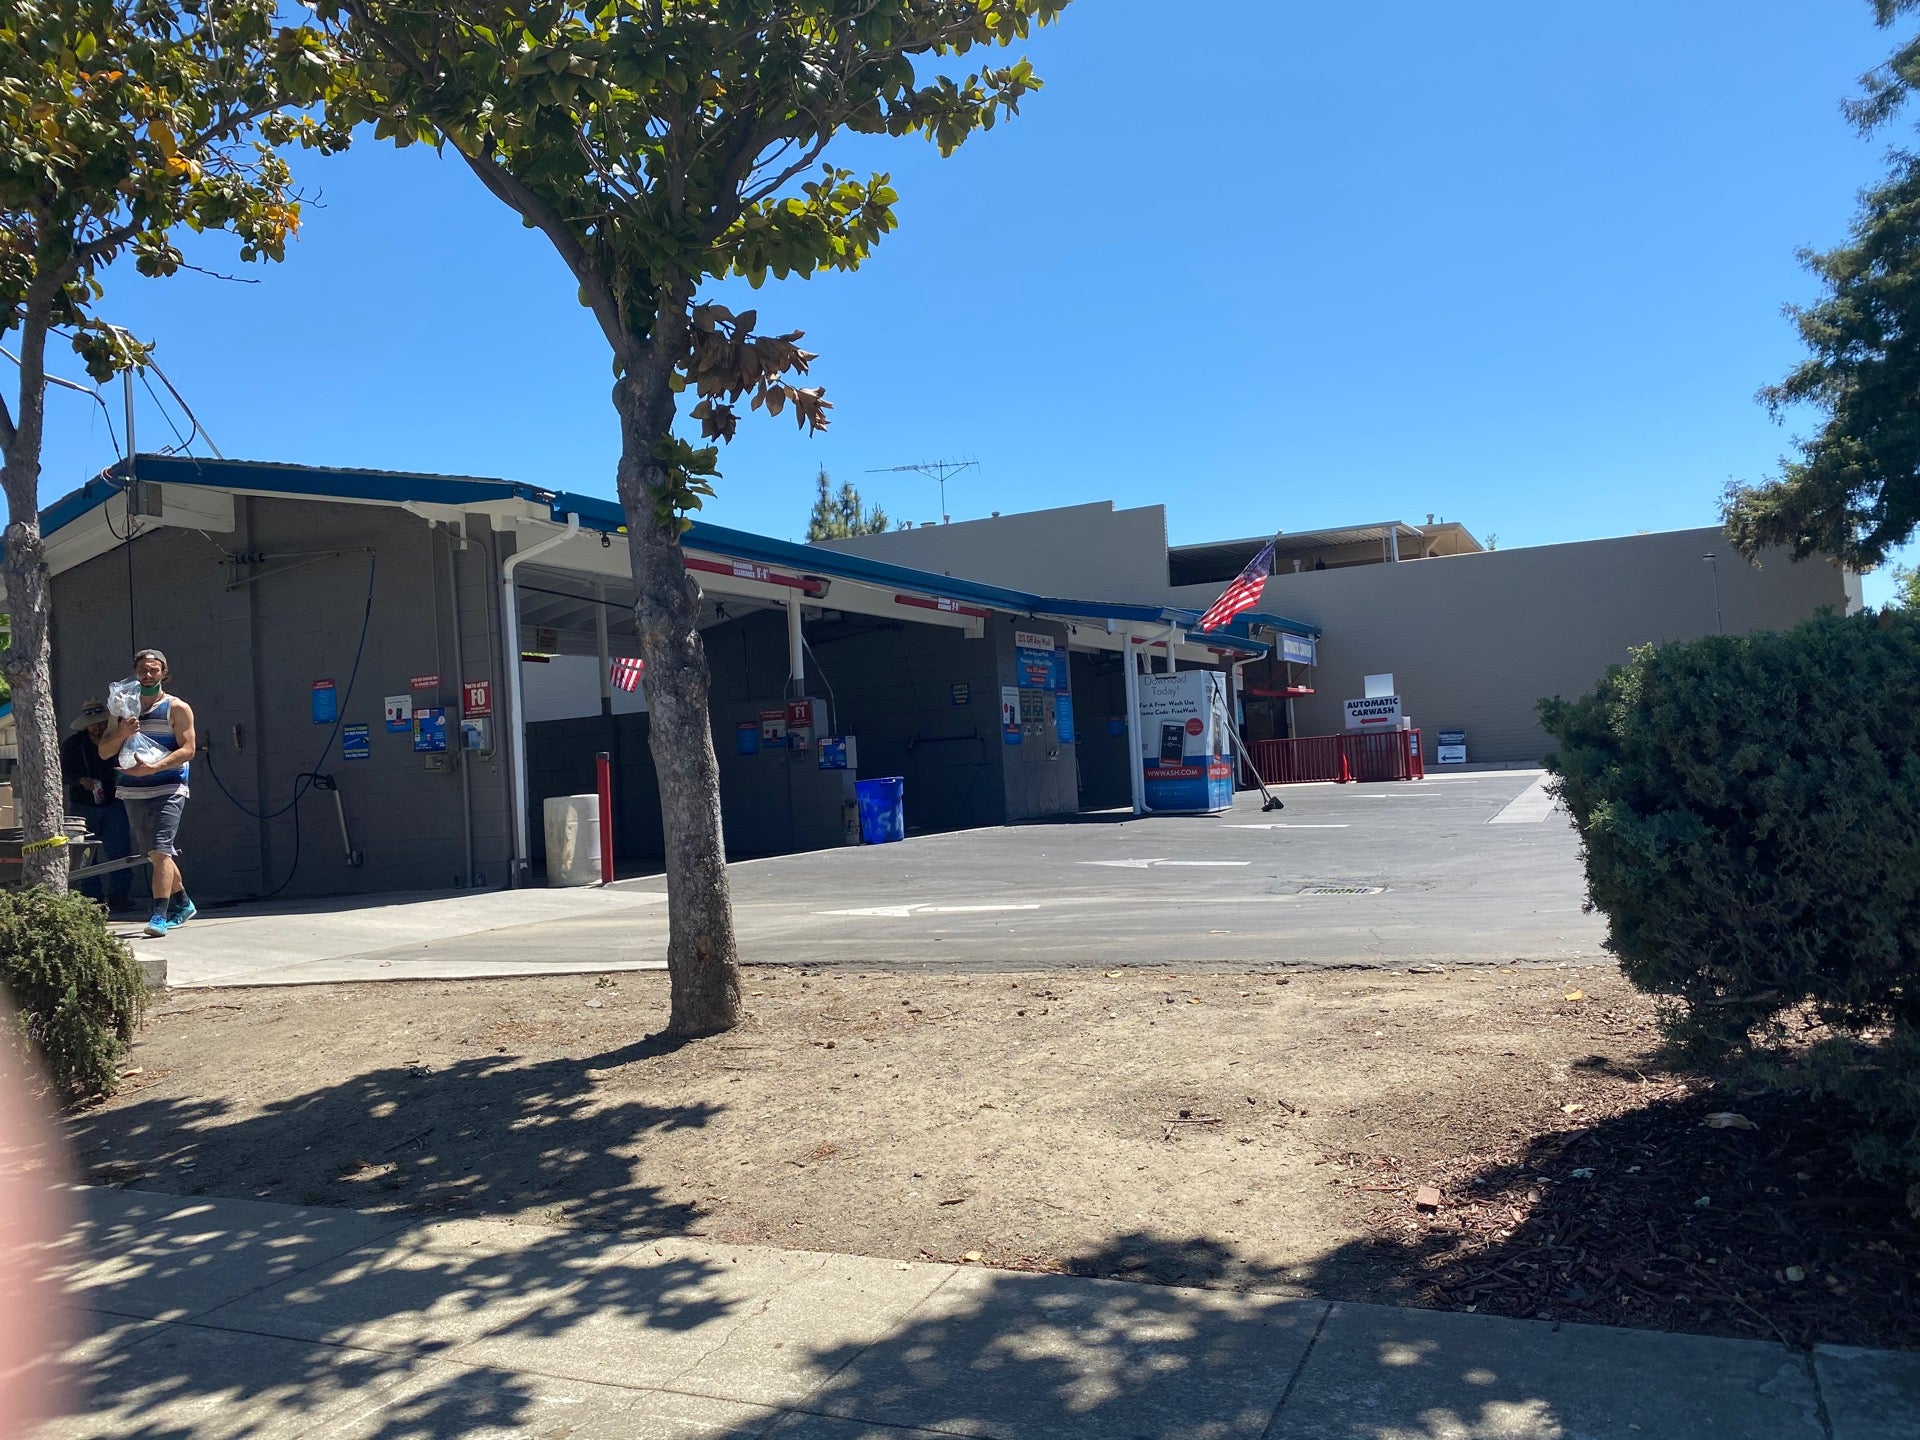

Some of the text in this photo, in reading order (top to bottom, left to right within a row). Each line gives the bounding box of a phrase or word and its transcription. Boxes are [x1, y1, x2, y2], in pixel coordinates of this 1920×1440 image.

[1347, 697, 1399, 709] AUTOMATIC
[1351, 706, 1395, 717] CARWASH
[1147, 769, 1198, 777] WWWASH.COM
